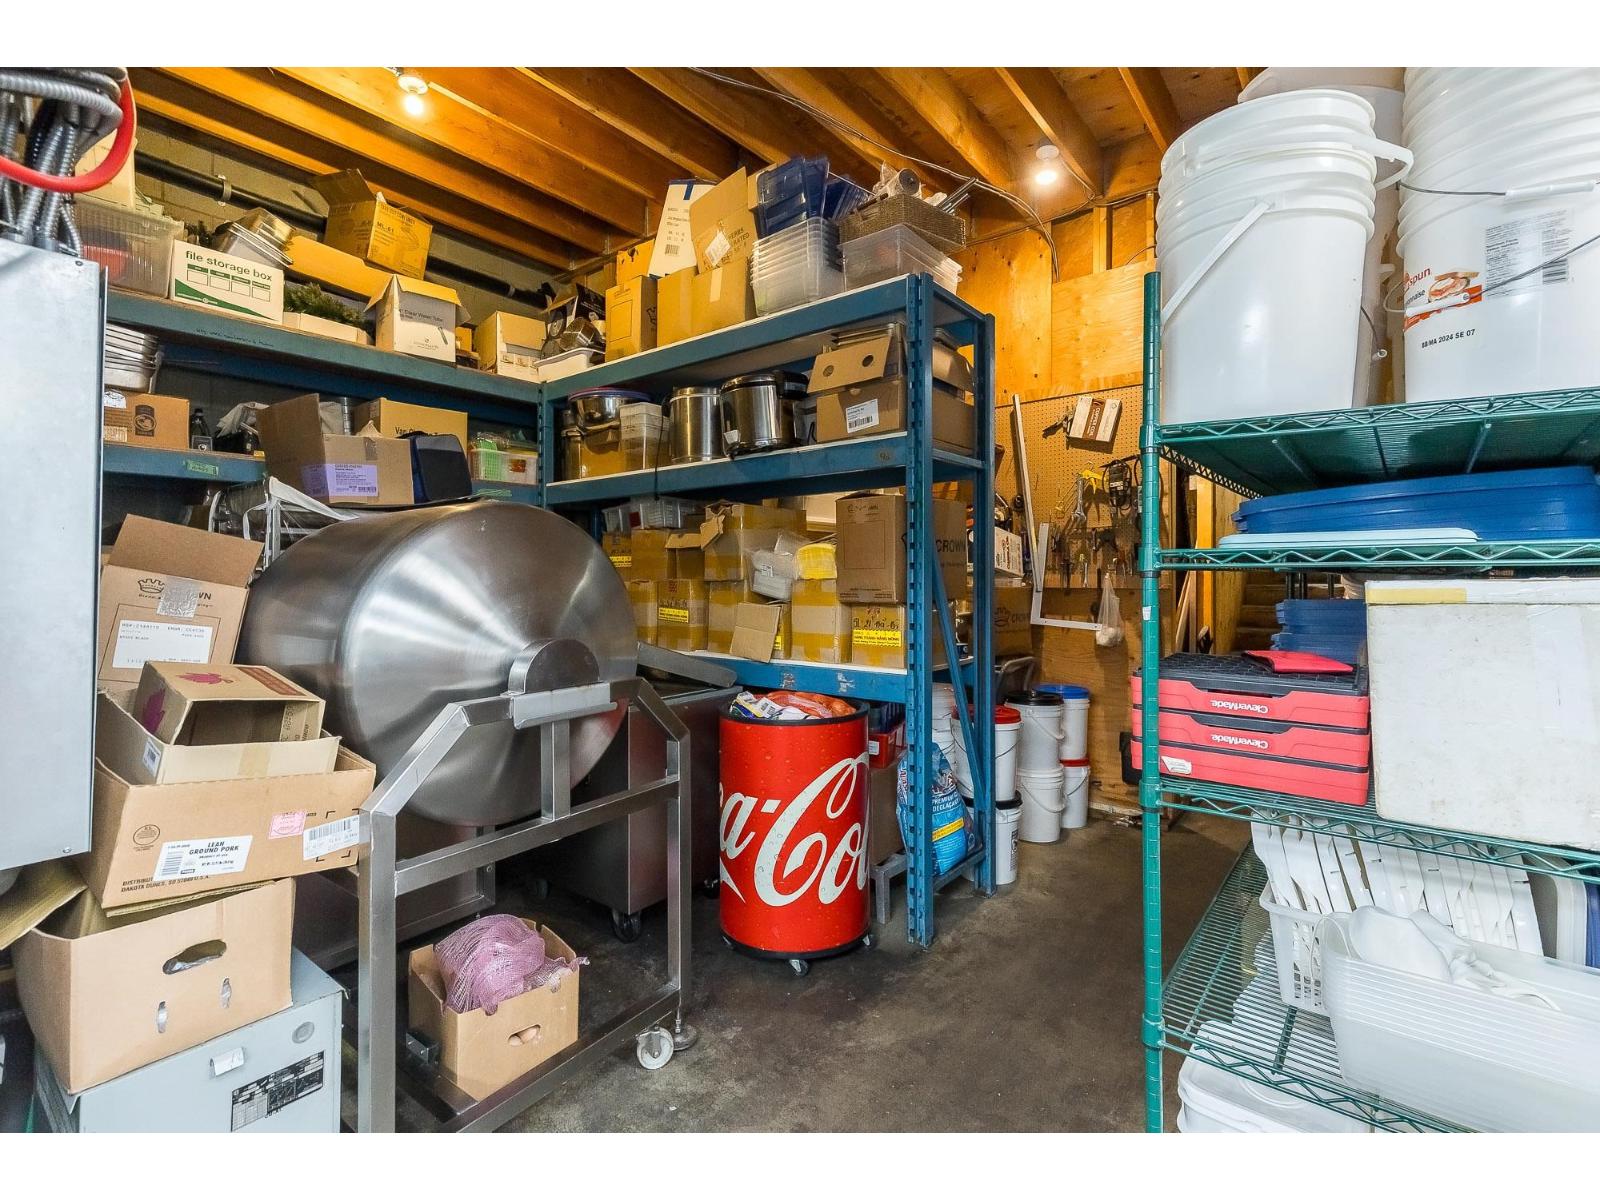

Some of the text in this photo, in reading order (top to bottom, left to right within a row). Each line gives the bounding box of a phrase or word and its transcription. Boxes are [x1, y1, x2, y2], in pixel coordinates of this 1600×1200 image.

[185, 250, 203, 262] file
[206, 257, 250, 275] storage
[253, 268, 272, 281] box
[1438, 333, 1454, 343] 2024
[1455, 331, 1464, 339] SE
[1466, 328, 1476, 337] 07
[1210, 700, 1269, 714] CleverMade
[1210, 734, 1269, 749] CleverMade
[189, 847, 219, 855] GROUND
[121, 884, 144, 892] DAKOTA
[122, 876, 154, 886] DISTRIBUT
